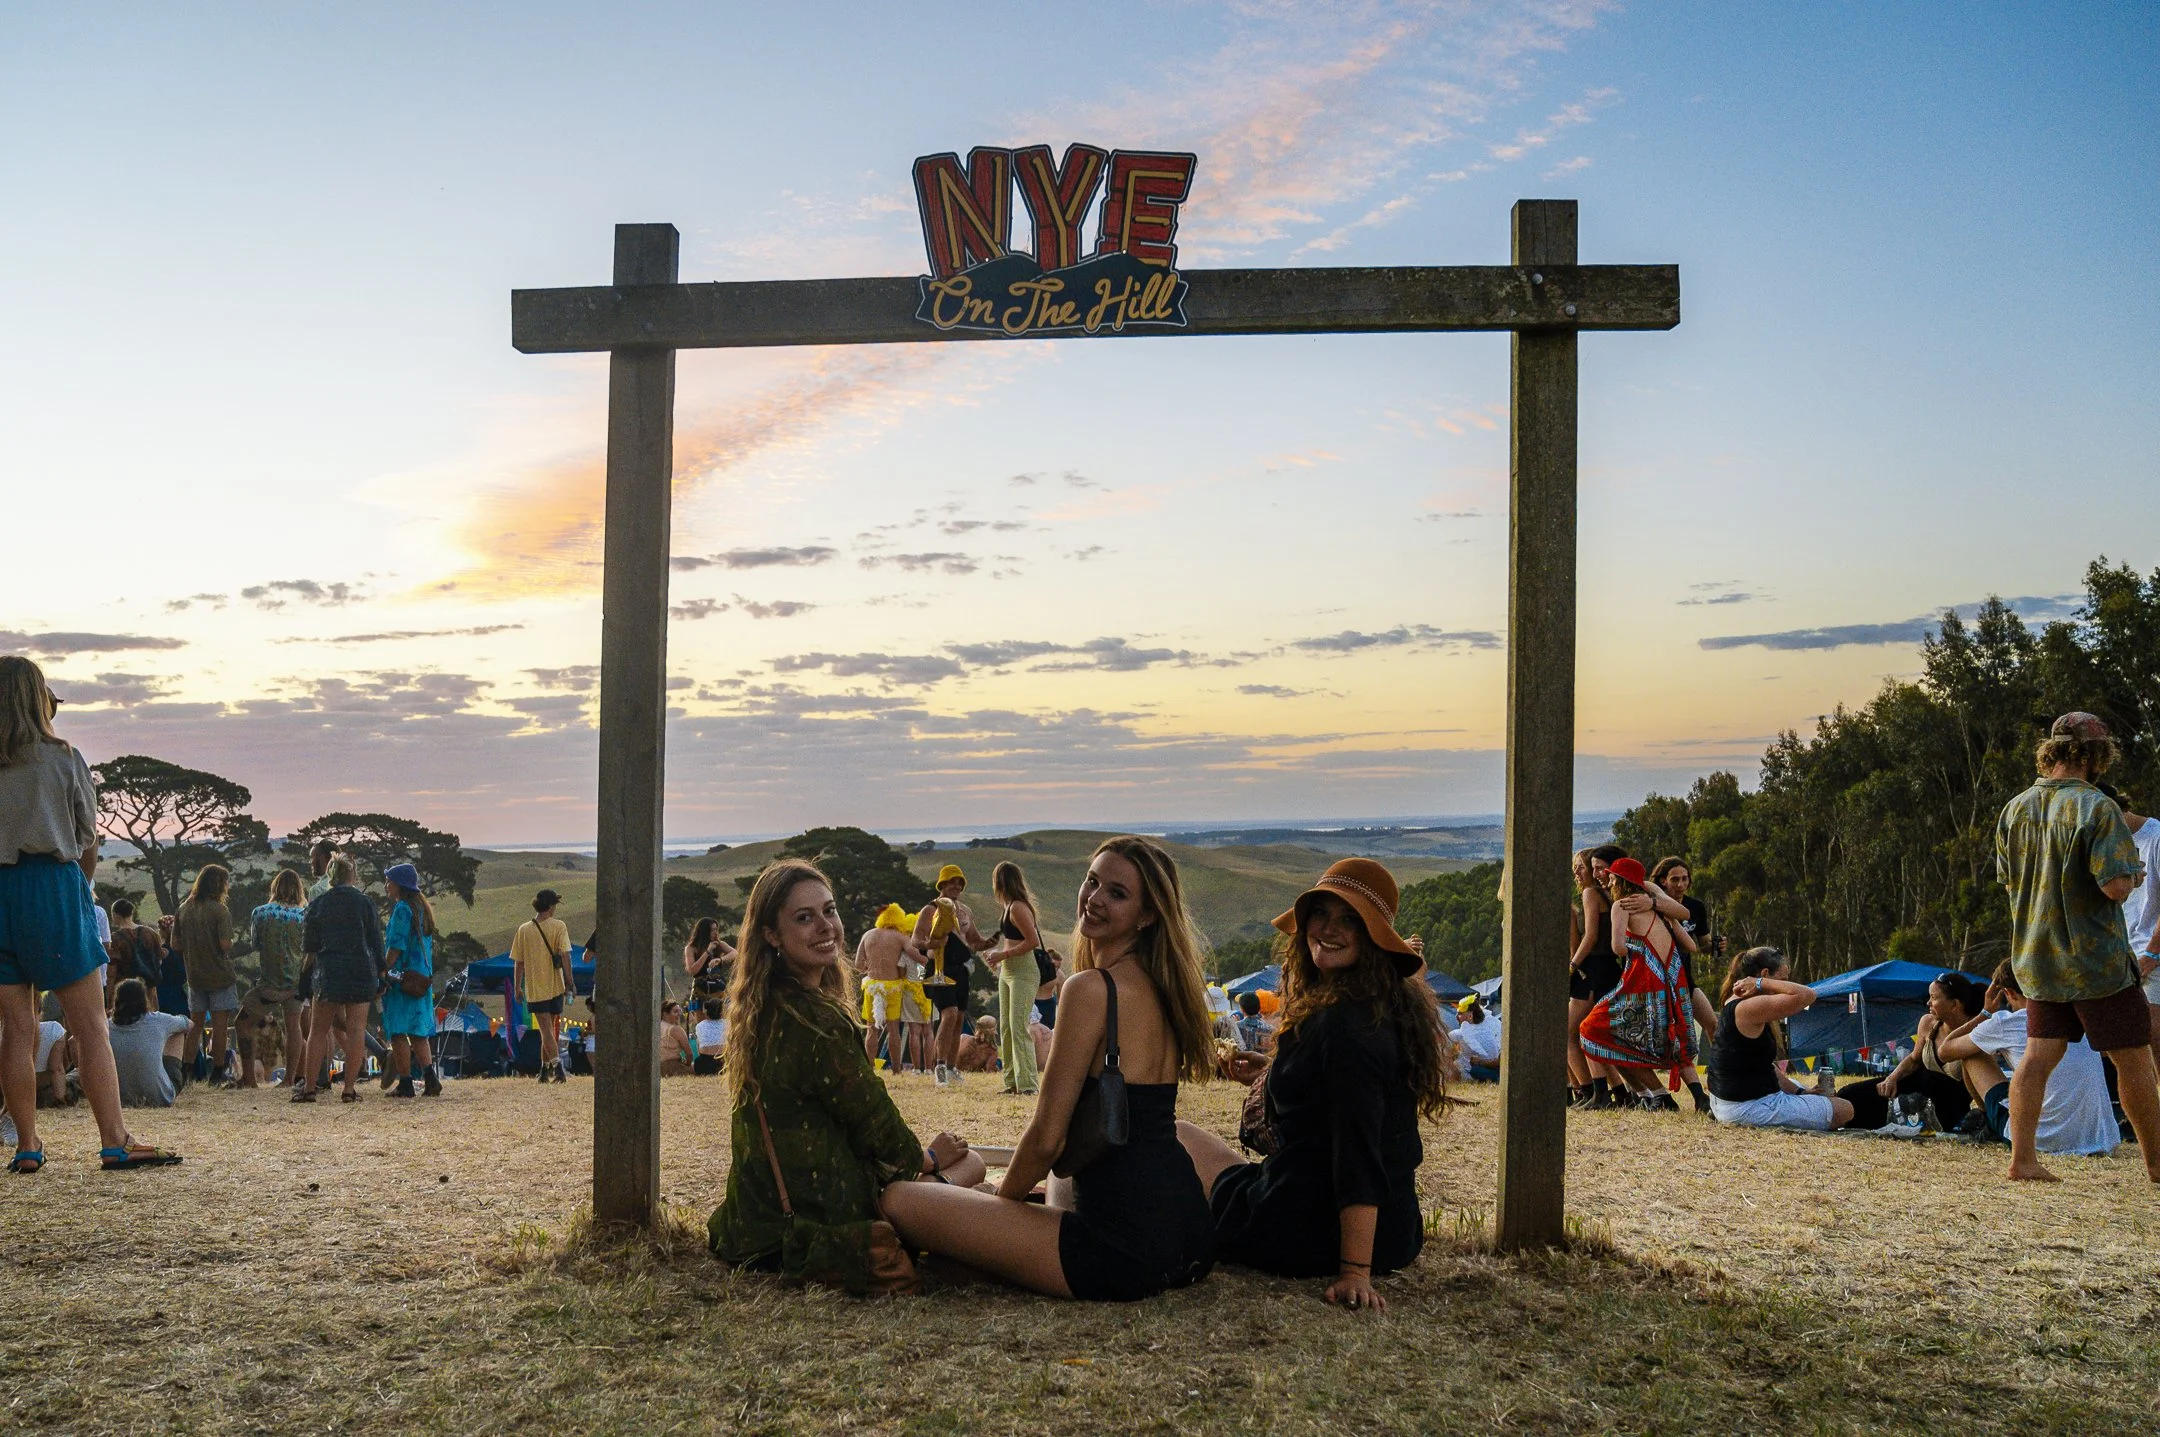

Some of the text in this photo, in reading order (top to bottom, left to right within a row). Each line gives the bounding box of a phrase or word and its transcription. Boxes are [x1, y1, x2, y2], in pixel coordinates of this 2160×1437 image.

[914, 143, 1197, 277] NYE
[929, 272, 1178, 333] On The Hill
